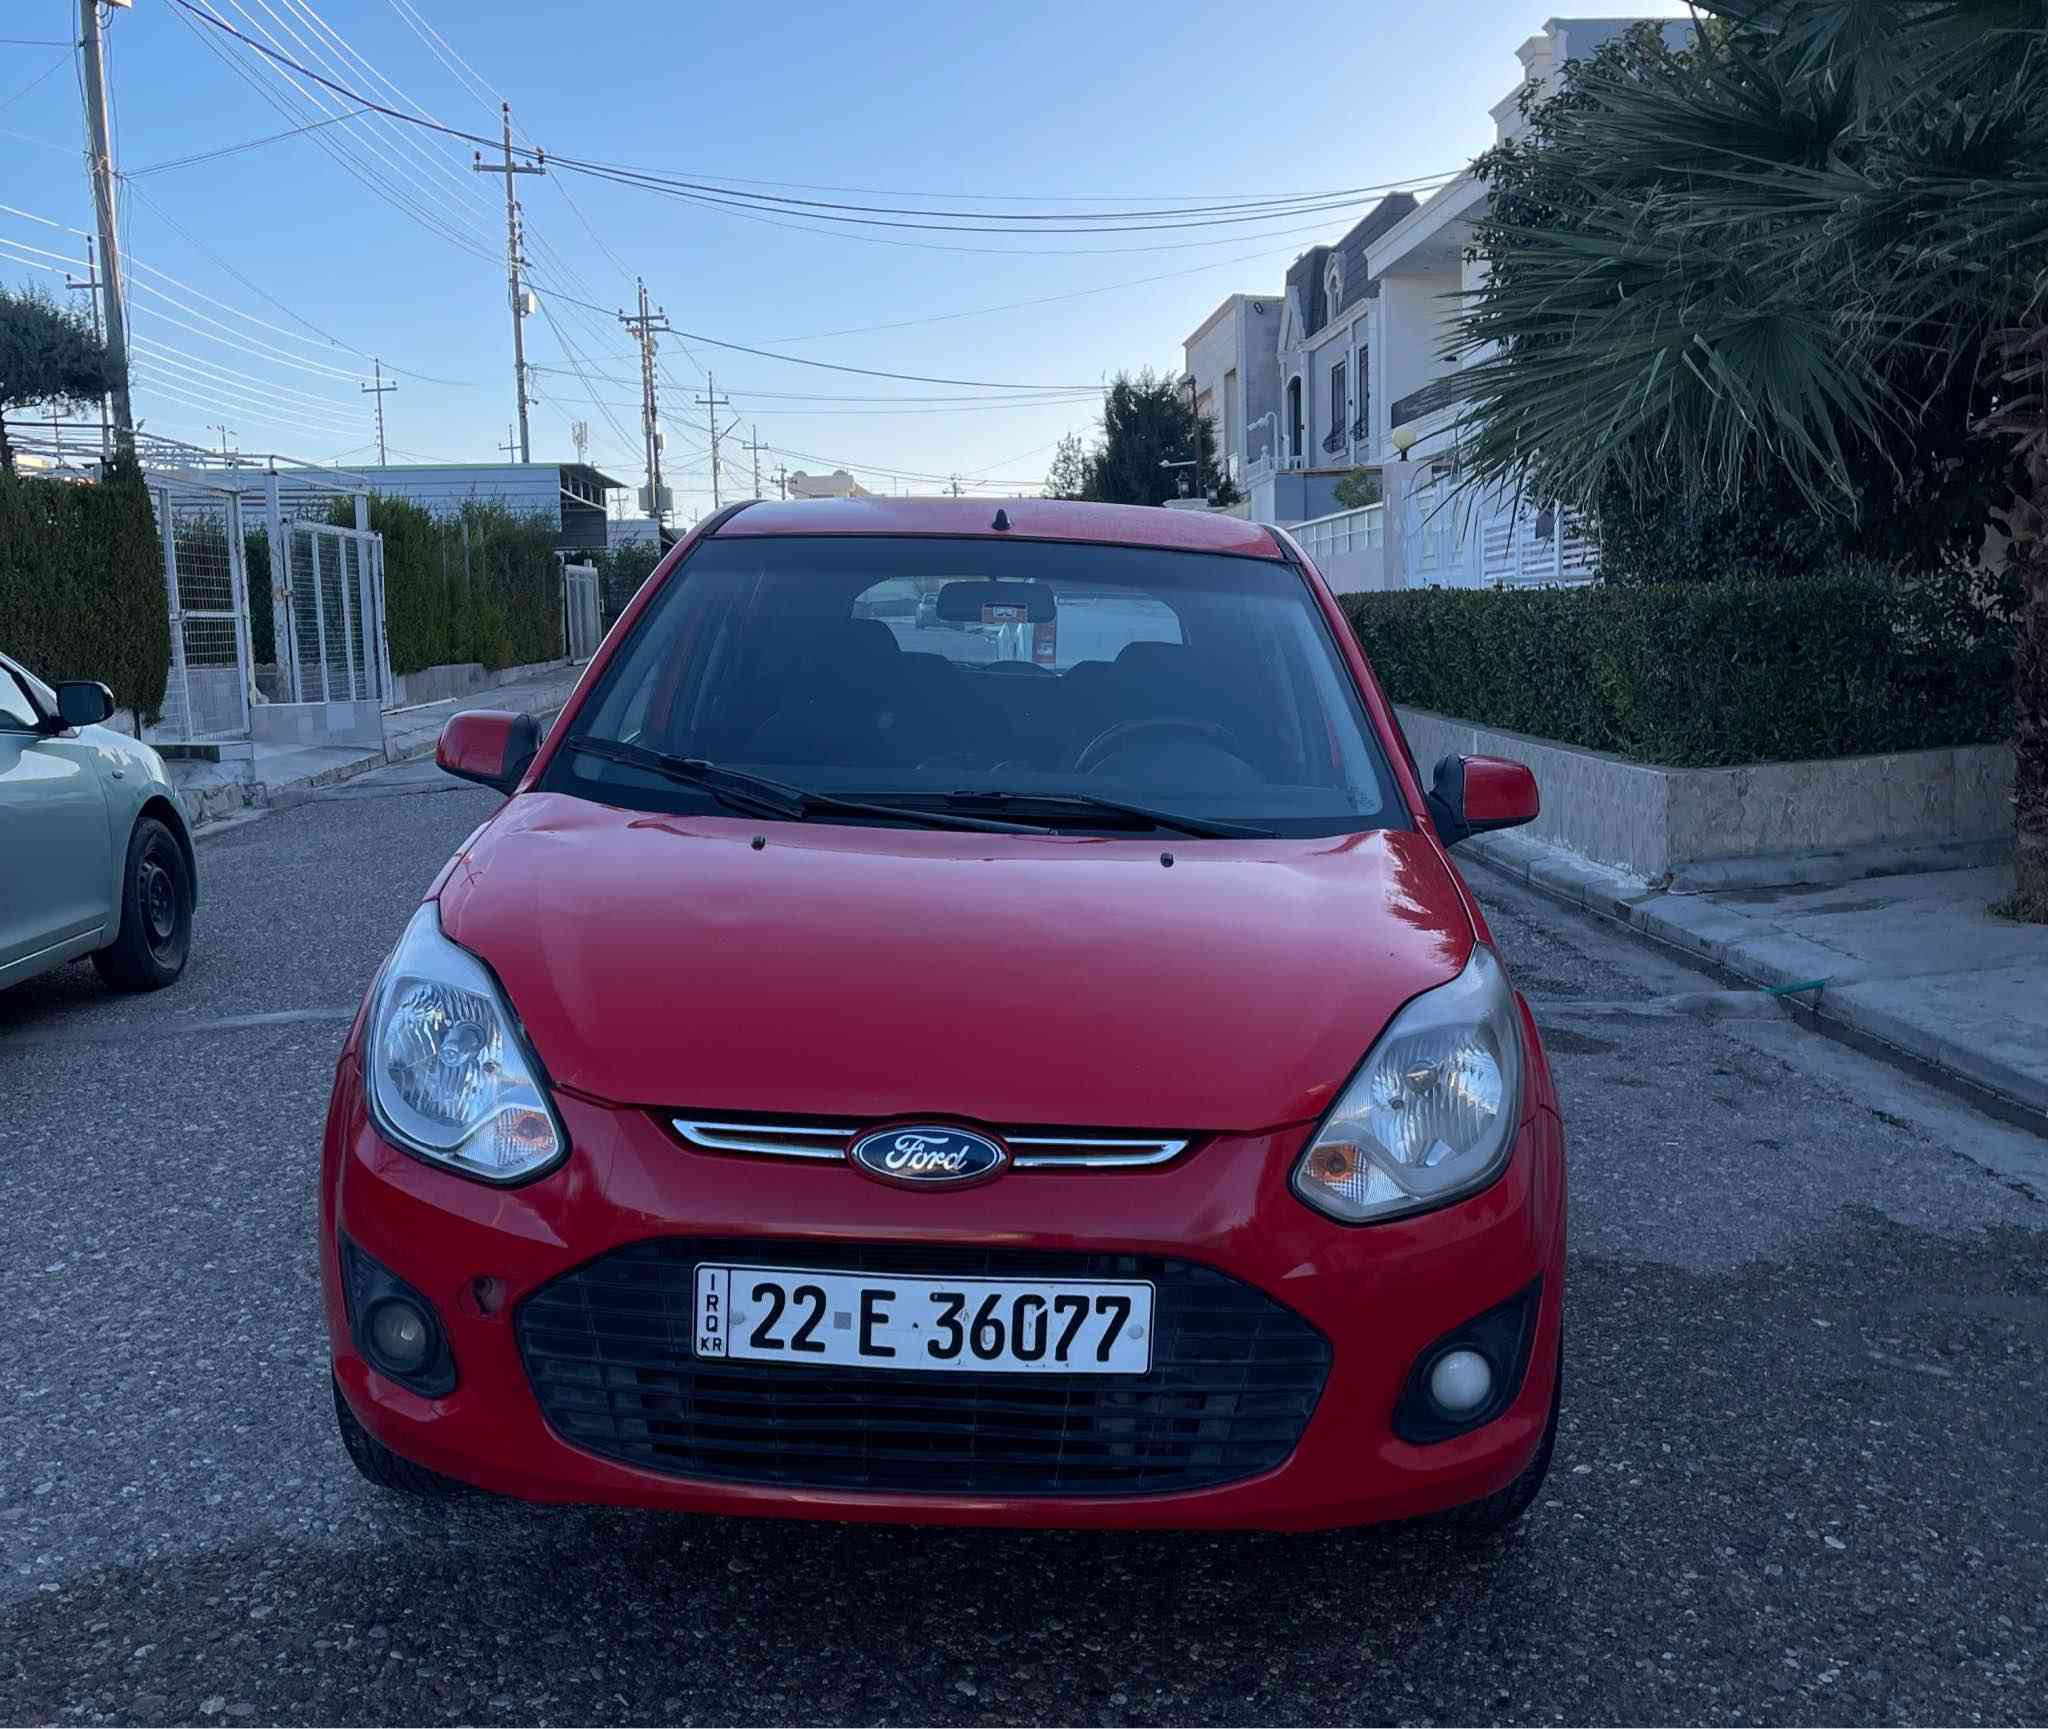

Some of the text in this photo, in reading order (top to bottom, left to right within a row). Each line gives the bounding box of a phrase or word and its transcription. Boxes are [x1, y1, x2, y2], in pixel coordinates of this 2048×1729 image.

[885, 1134, 970, 1170] Ford
[749, 1283, 1132, 1362] 22 E 36077
[700, 1336, 722, 1352] KR
